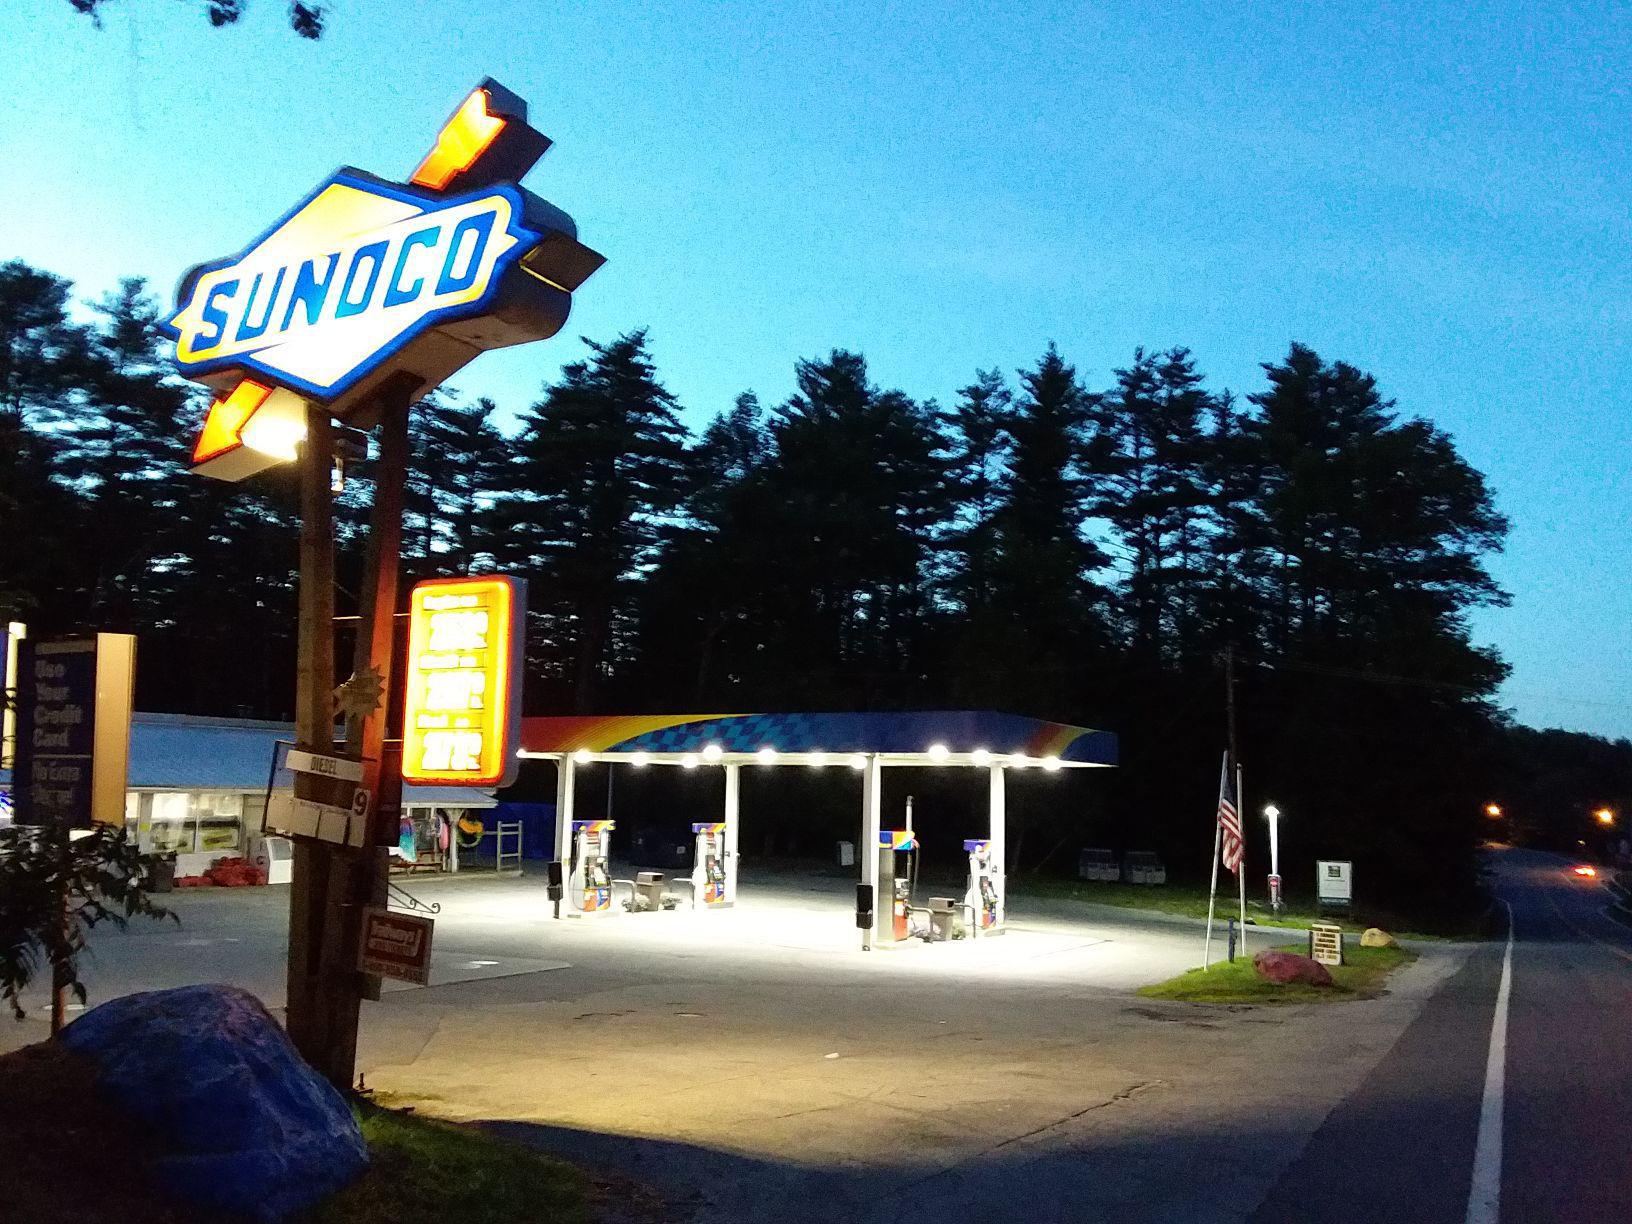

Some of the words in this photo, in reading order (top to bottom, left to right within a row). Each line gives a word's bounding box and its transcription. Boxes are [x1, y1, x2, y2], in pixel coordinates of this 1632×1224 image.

[191, 210, 497, 352] SUNOCO
[311, 757, 337, 774] DIESEL
[355, 792, 368, 815] 9
